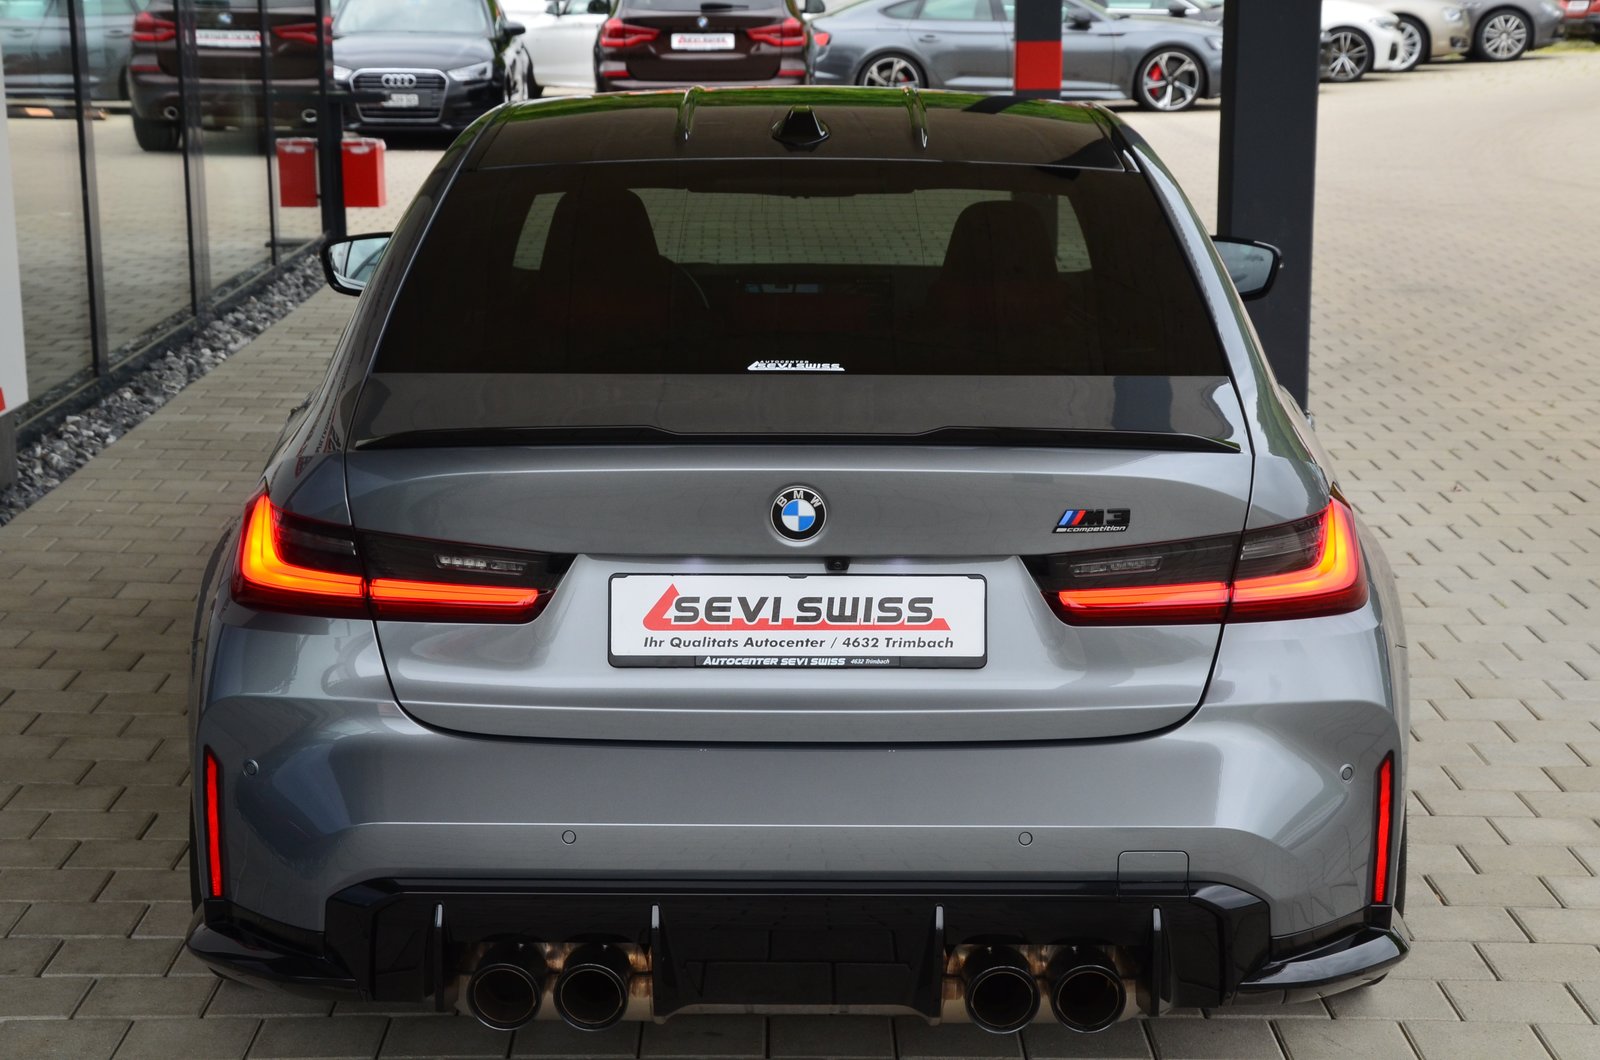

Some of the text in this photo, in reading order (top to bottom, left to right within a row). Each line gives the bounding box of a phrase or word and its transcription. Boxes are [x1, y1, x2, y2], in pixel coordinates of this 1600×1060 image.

[776, 490, 822, 508] BMW
[1081, 508, 1131, 525] M3
[1066, 525, 1127, 533] competition
[673, 596, 934, 623] SEVI SWISS
[643, 637, 665, 648] Ihr
[669, 636, 739, 648] Qualitats
[743, 637, 826, 648] Autocenter
[842, 637, 879, 648] 4632
[884, 637, 954, 649] Trimbach
[780, 657, 808, 666] SEVI
[810, 657, 846, 666] SWISS
